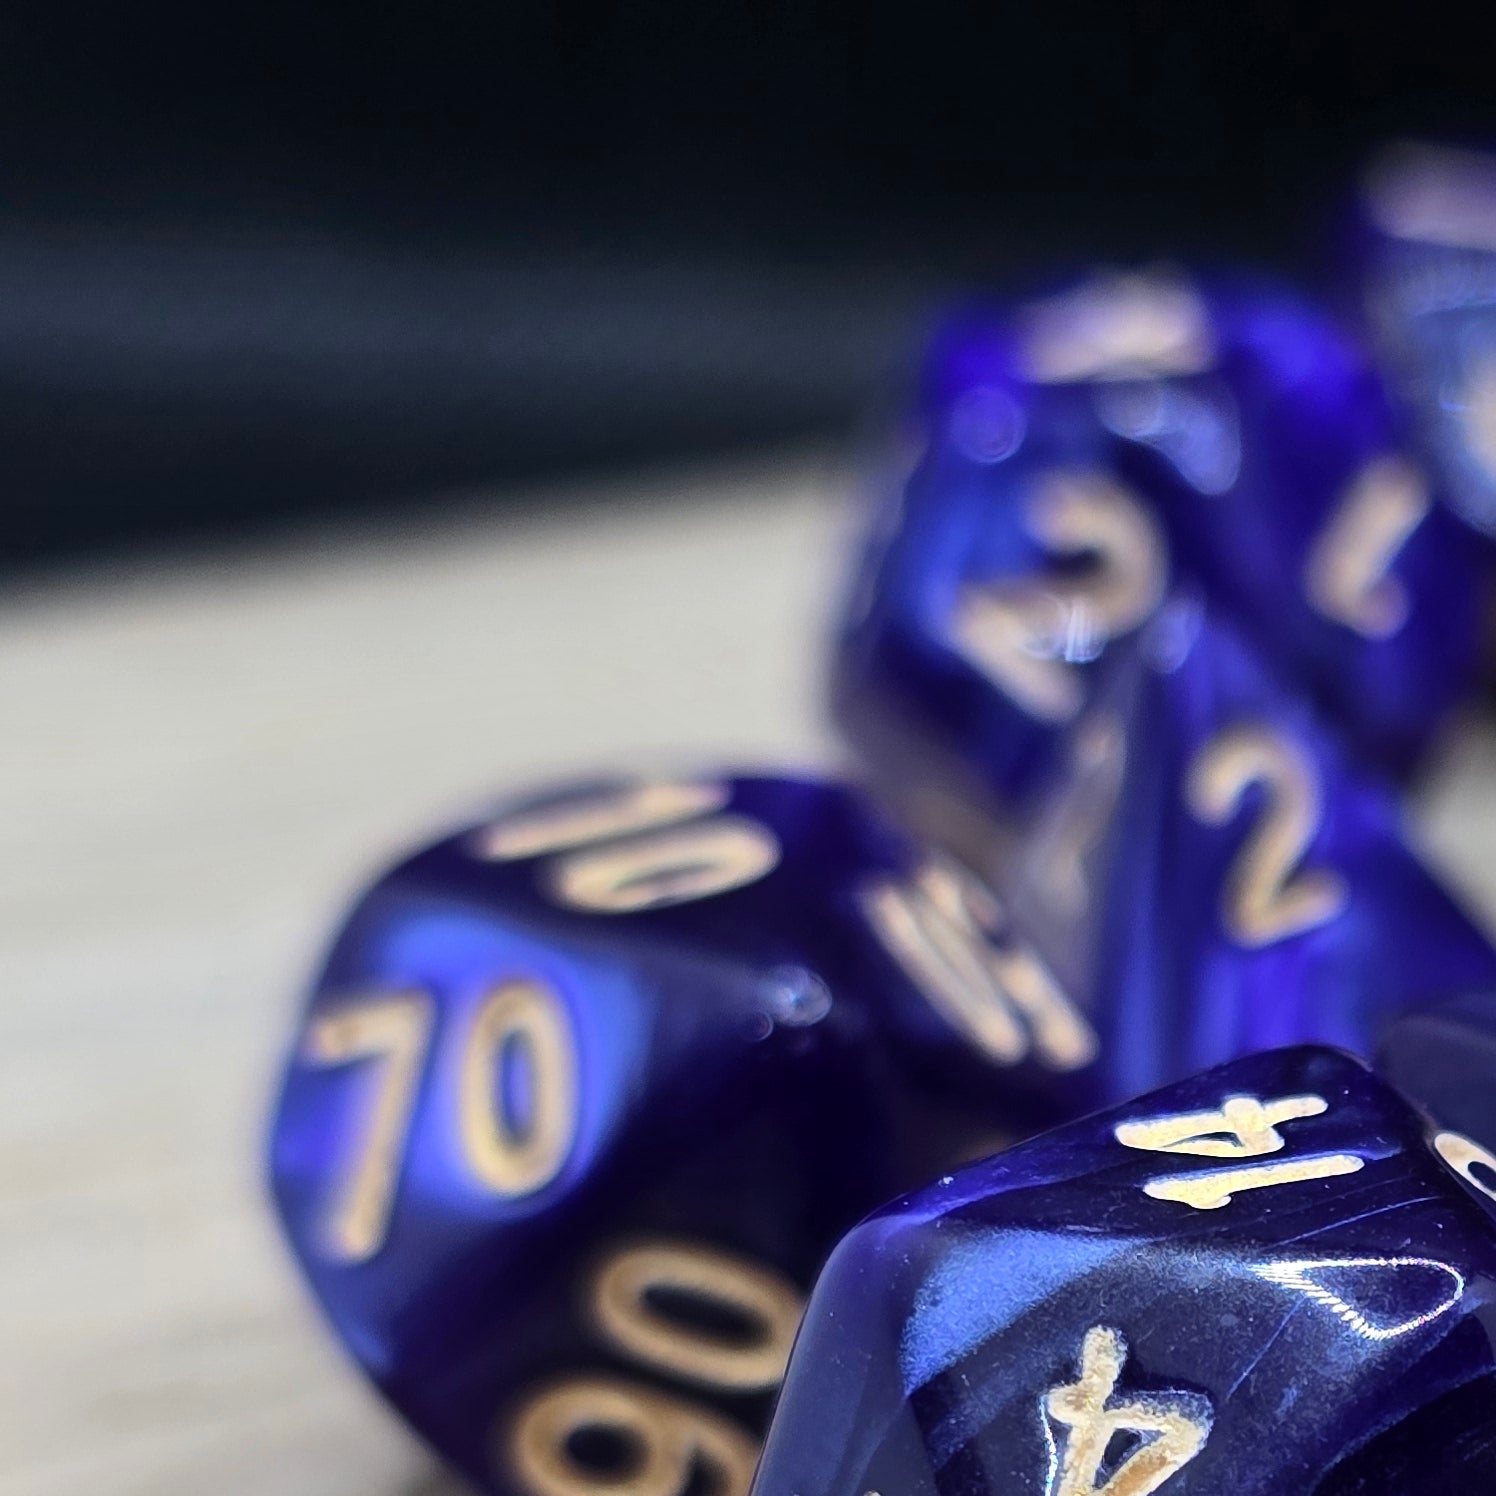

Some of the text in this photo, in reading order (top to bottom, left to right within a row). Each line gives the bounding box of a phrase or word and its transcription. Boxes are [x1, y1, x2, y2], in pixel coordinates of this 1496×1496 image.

[1190, 725, 1348, 946] 2
[306, 974, 580, 1265] 70
[1115, 1096, 1366, 1209] 14
